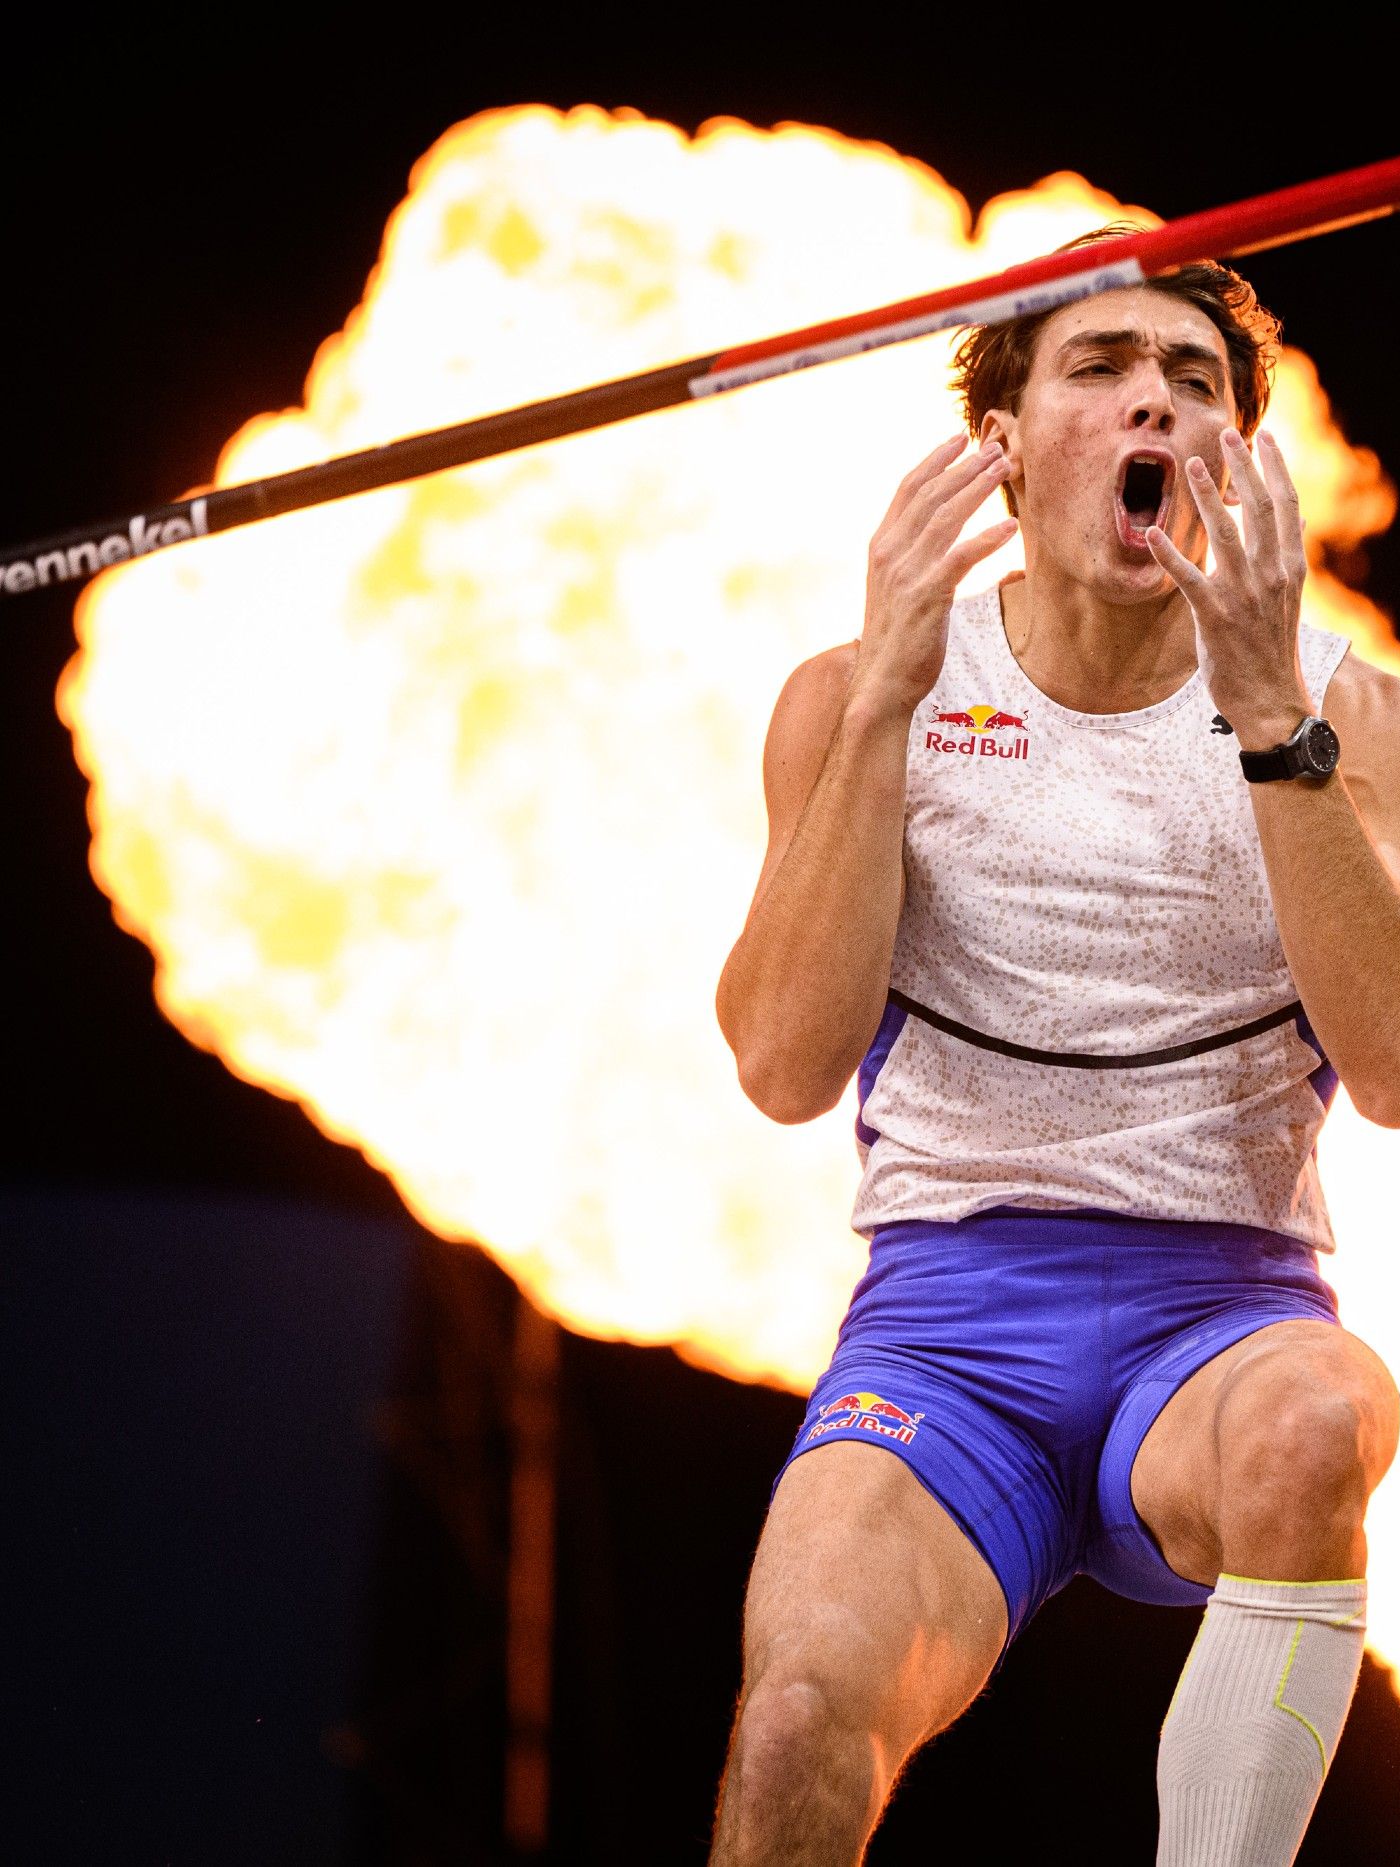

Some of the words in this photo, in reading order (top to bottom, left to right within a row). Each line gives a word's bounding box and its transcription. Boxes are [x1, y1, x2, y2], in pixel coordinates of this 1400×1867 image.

[0, 499, 208, 594] ennekel
[925, 731, 976, 755] Red
[980, 738, 1029, 760] Bull
[805, 1411, 859, 1443] Red
[857, 1415, 917, 1446] Bull
